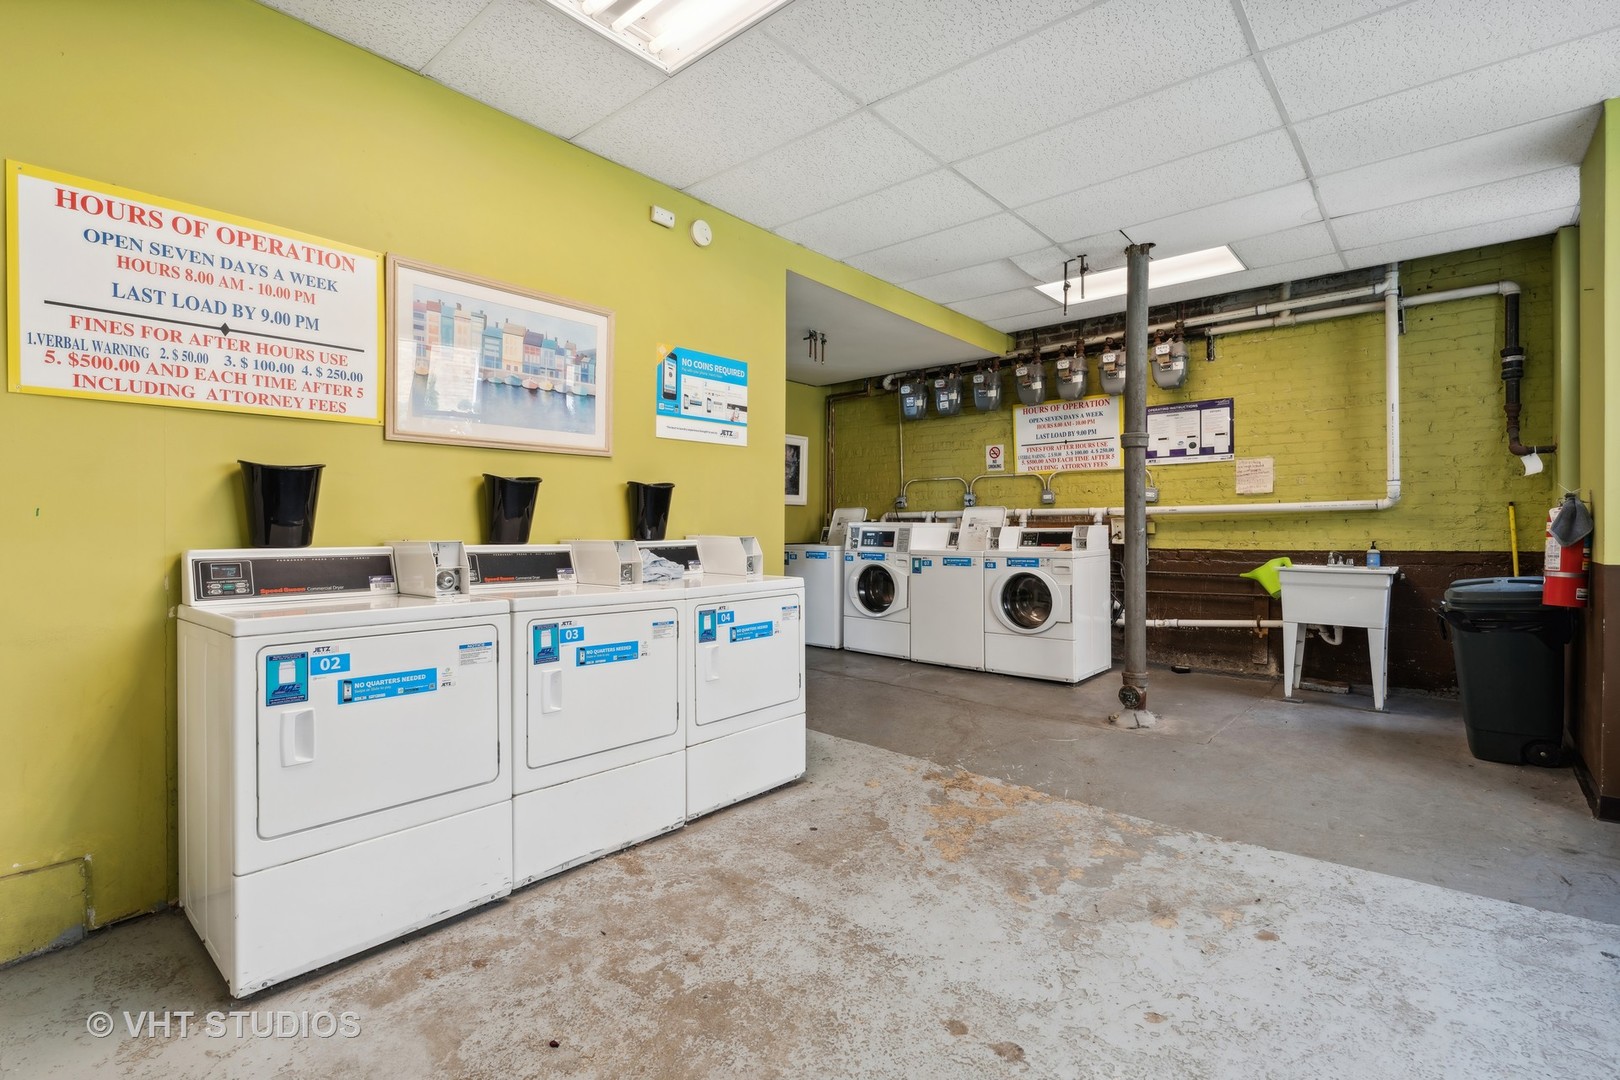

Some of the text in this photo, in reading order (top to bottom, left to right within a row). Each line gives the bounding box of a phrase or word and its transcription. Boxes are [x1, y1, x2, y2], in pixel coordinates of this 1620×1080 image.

[54, 188, 356, 272] HOURS OF OPERATION
[83, 228, 338, 292] OPEN SEVEN DAYS A WEEK
[117, 255, 180, 279] HOURS
[185, 268, 214, 286] 8.00
[218, 276, 244, 291] AM
[258, 283, 290, 300] 10.00
[294, 290, 316, 305] PM
[112, 282, 320, 331] LAST LOAD BY 9.00 PM
[70, 315, 348, 367] FINES FOR AFTER HOURS USE
[92, 340, 150, 359] WARNING
[160, 348, 169, 360] 2.
[182, 350, 208, 364] 50.00
[224, 356, 236, 367] 3.
[253, 359, 294, 374] 100.00
[302, 365, 312, 376] 4.
[326, 368, 363, 382] 250.00
[44, 350, 364, 398] 5. $500.00 AND EACH TIME AFTER 5
[682, 358, 692, 367] NO
[694, 360, 714, 372] COINS
[714, 366, 745, 378] REQUIRED
[72, 374, 346, 414] INCLUDING ATTORNEY FEES
[1022, 406, 1048, 415] HOURS
[1062, 399, 1110, 410] OPERATION
[565, 629, 579, 640] 03
[721, 613, 730, 622] 04
[320, 657, 340, 670] 02
[366, 678, 400, 688] QUARTERS
[402, 674, 426, 683] NEEDED
